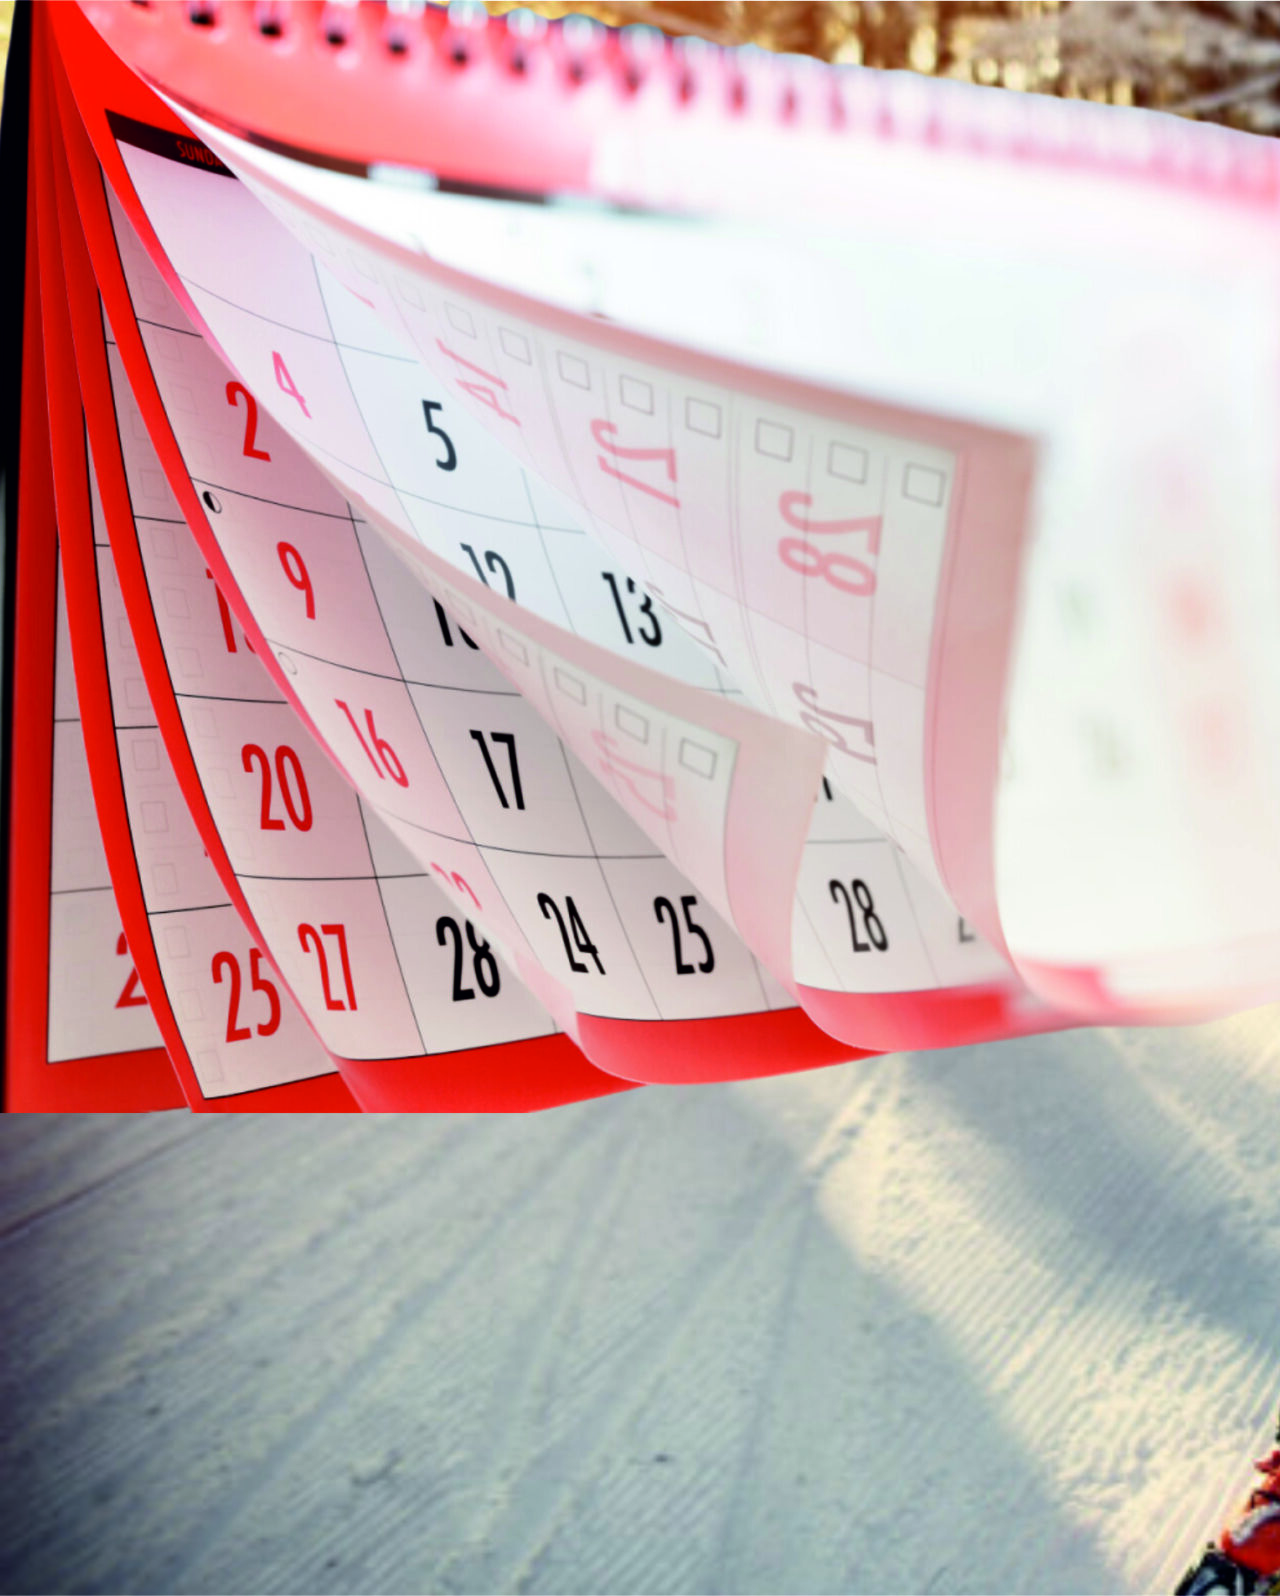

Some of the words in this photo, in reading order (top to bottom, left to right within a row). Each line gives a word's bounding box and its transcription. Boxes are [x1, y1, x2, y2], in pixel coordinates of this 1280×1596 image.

[225, 380, 272, 463] 2
[271, 349, 312, 420] 4
[421, 398, 458, 472] 5
[276, 541, 316, 621] 9
[601, 571, 662, 648] 13
[333, 698, 410, 789] 16
[469, 728, 526, 811] 17
[241, 743, 313, 832] 20
[536, 892, 606, 976] 24
[653, 895, 716, 976] 25
[828, 877, 890, 953] 28
[211, 946, 281, 1044] 25
[297, 922, 358, 1012] 27
[435, 915, 501, 1002] 28
